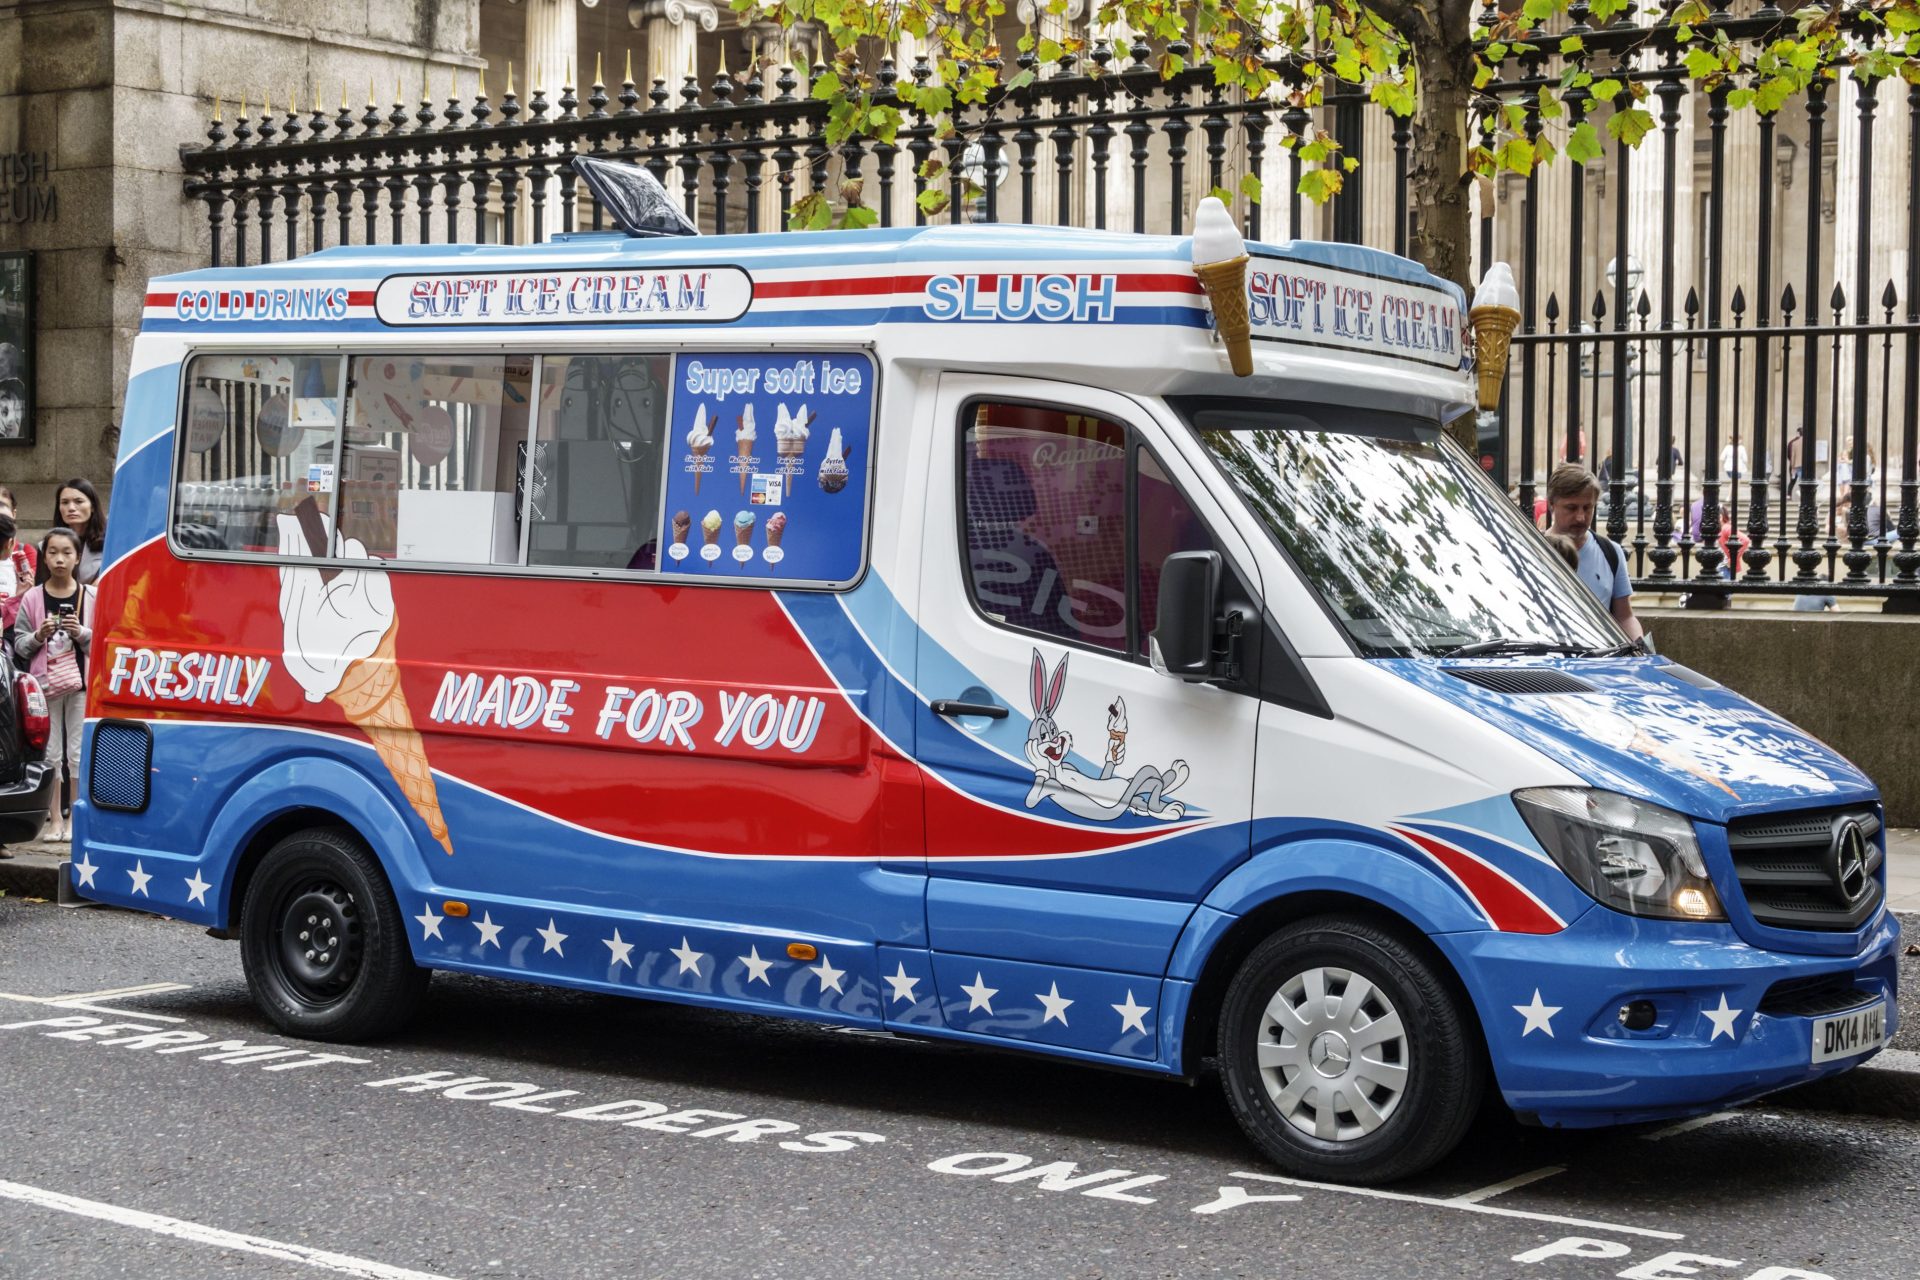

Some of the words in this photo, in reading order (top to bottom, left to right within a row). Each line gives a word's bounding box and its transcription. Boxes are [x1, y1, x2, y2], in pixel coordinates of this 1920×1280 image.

[176, 289, 246, 321] COLD
[253, 286, 348, 321] DRINKS
[407, 277, 498, 318] SOFT
[503, 276, 561, 316] ICE
[567, 272, 711, 315] CREAM
[924, 274, 1116, 321] SLUSH
[1249, 270, 1327, 333] SOFT
[1333, 284, 1373, 340] ICE
[1381, 294, 1455, 355] CREAM
[686, 360, 760, 401] Super
[764, 359, 815, 394] soft
[820, 360, 861, 394] ice
[108, 646, 272, 707] FRESHLY
[430, 670, 580, 733] MADE
[595, 685, 704, 751] FOR
[714, 689, 826, 753] YOU
[1823, 1016, 1858, 1054] DK14
[1862, 1009, 1880, 1045] AHL
[0, 1016, 373, 1071] PERMIT
[362, 1070, 886, 1152] HOLDERS
[926, 1152, 1303, 1214] ONLY
